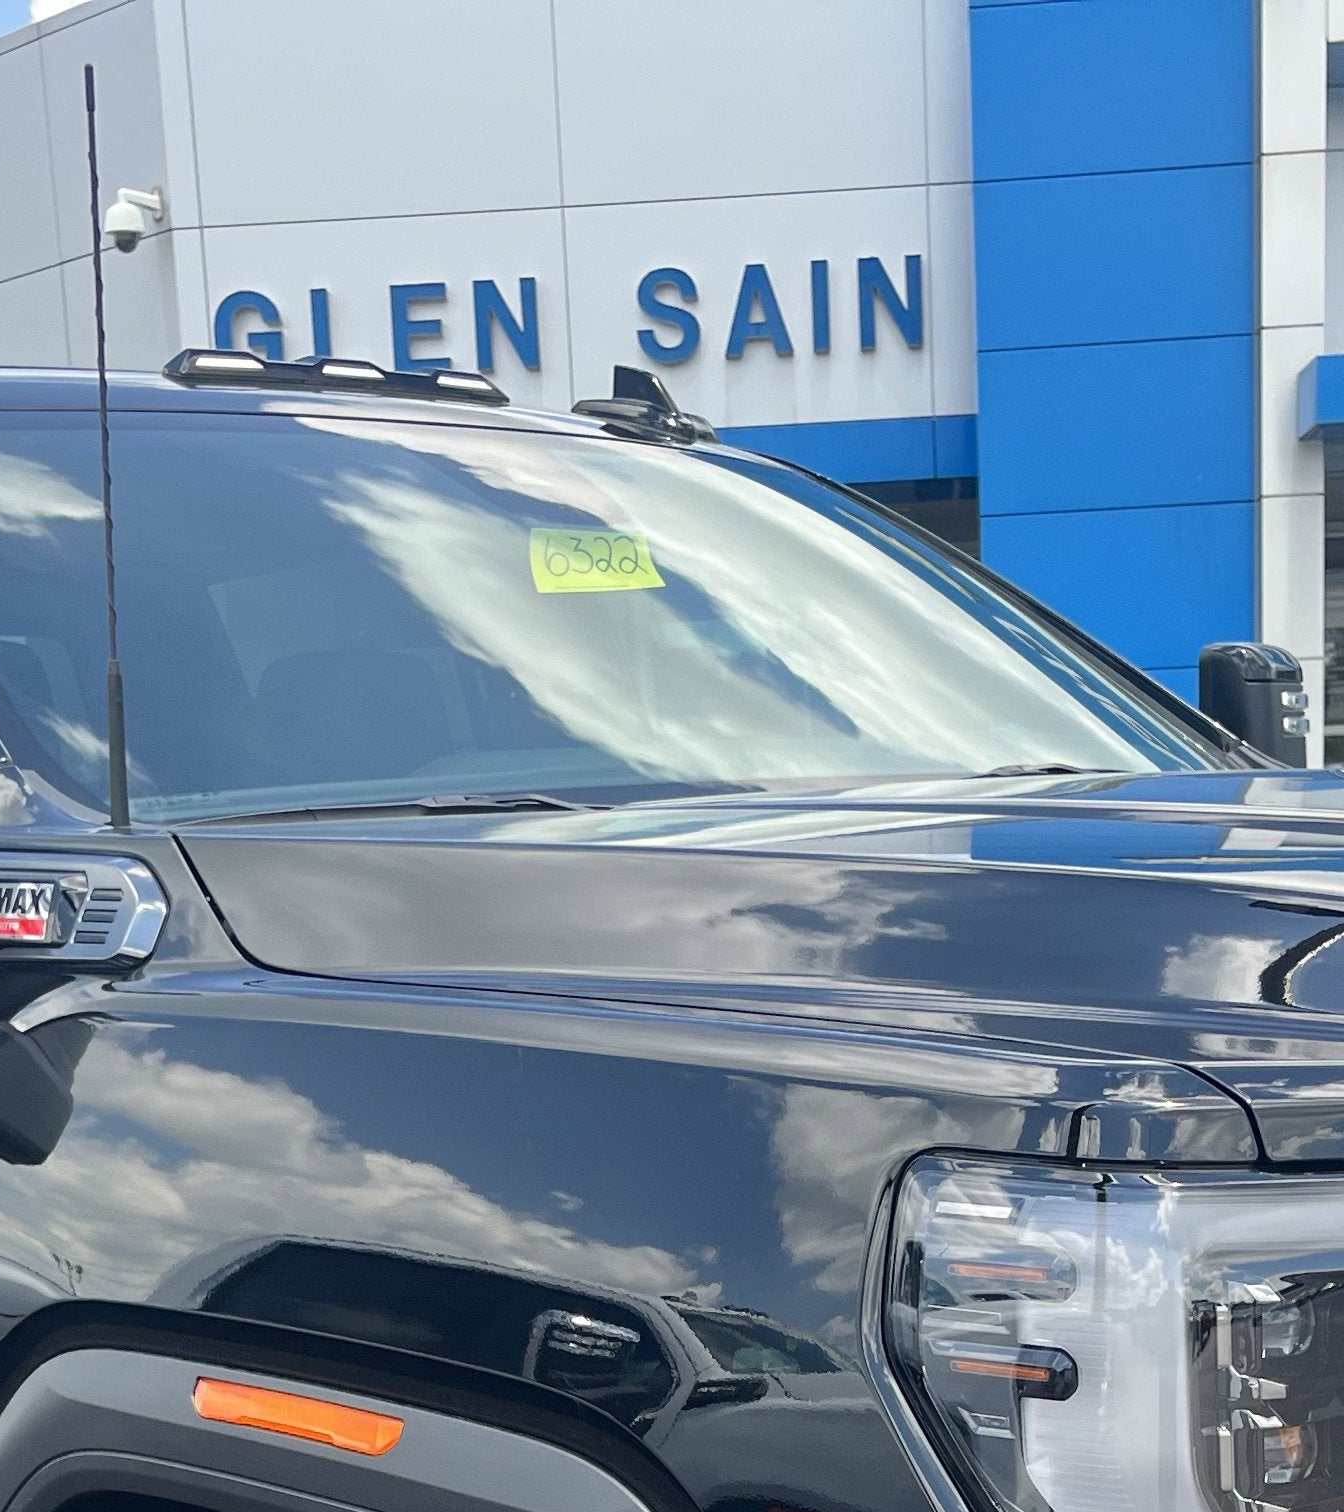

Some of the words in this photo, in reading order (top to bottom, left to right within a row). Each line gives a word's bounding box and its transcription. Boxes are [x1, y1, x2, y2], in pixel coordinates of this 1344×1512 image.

[214, 277, 541, 373] GLEN
[636, 254, 924, 366] SAIN
[543, 534, 650, 578] 6322
